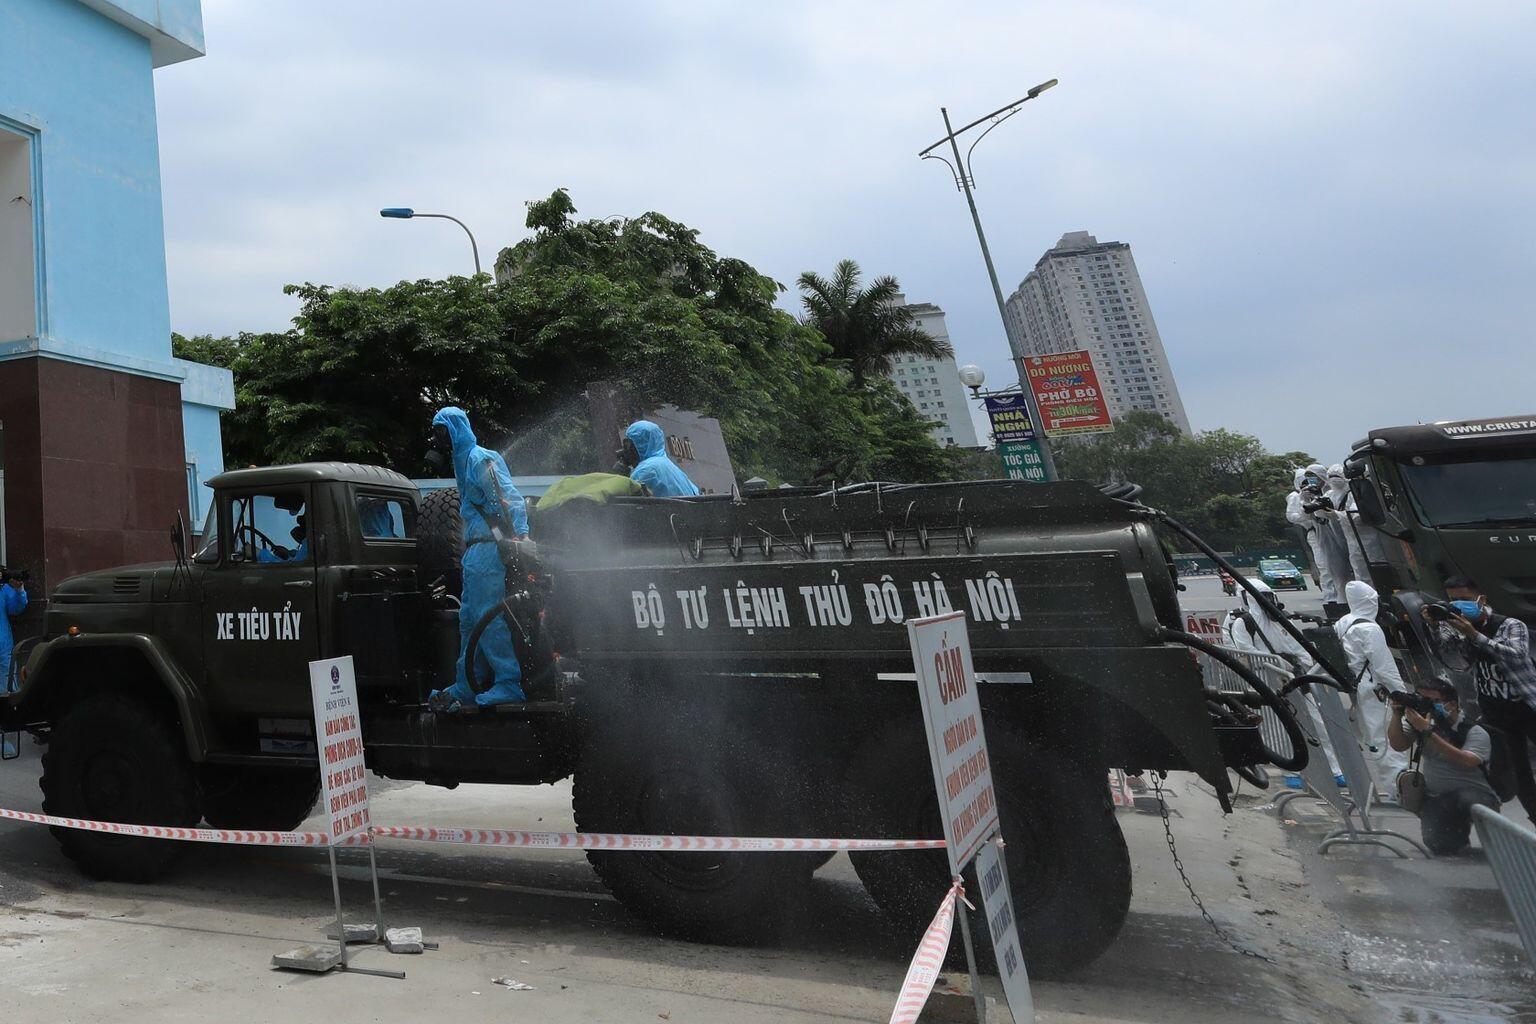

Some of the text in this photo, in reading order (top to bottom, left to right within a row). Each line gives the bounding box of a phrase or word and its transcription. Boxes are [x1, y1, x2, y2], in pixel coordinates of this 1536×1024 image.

[1049, 363, 1091, 375] NƯỚNG
[1038, 386, 1097, 401] PHỞ BÒ
[993, 408, 1024, 422] NHÀ
[994, 419, 1031, 432] NGHỈ
[1007, 444, 1031, 452] XƯỞNG
[1004, 450, 1041, 465] TÓC GIẢ
[1009, 466, 1044, 480] HÀ NỘI
[631, 569, 1022, 636] BỘ TƯ LỆNH THỦ ĐÔ HÀ NỘI
[216, 600, 301, 640] XE TIÊU TẨY
[934, 631, 967, 706] CẤM
